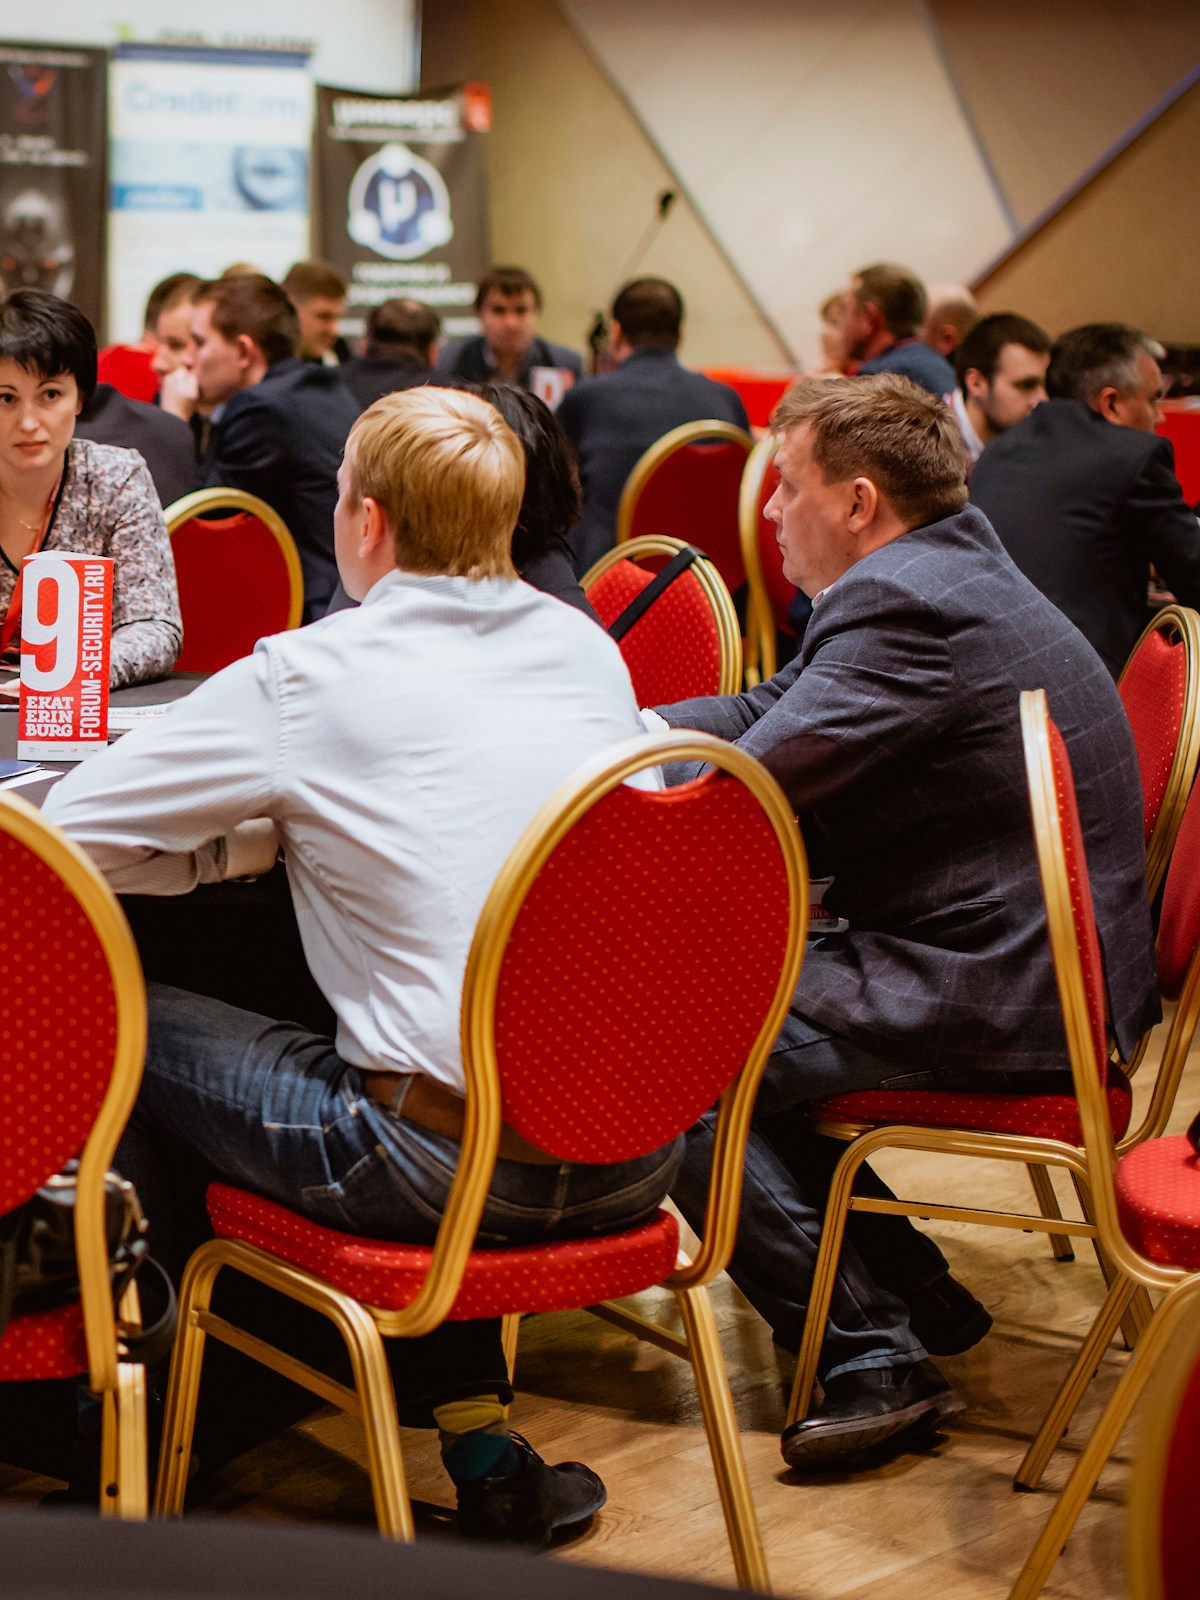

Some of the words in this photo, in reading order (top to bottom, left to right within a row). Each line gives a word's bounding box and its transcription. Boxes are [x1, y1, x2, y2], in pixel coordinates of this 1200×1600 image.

[20, 559, 80, 692] 9
[80, 564, 105, 738] FORUM-SECURITY.RU
[26, 696, 74, 709] EKAT
[25, 710, 73, 723] ERIN
[25, 724, 73, 737] BURG
